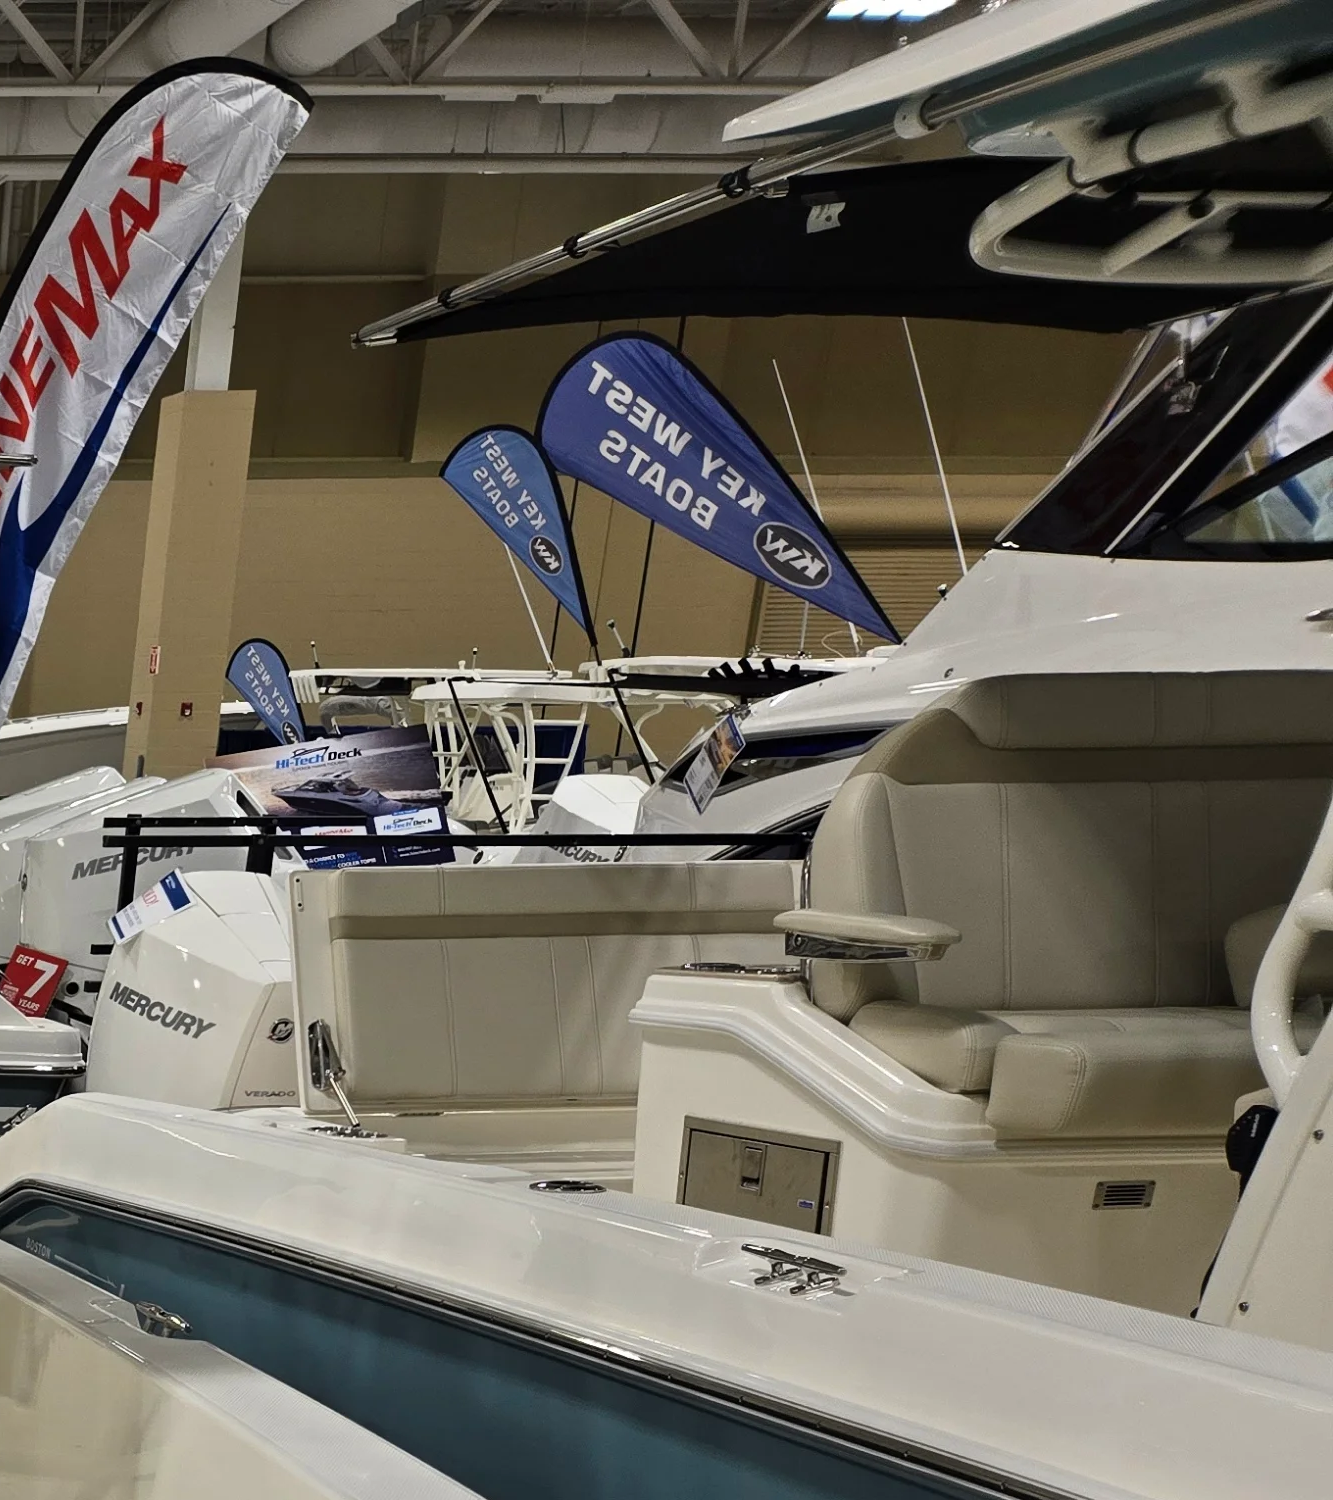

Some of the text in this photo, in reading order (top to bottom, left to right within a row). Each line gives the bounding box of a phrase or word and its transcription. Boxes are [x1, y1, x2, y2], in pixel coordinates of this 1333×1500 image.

[327, 747, 363, 761] Deck
[15, 953, 35, 967] GET
[23, 959, 59, 998] 7
[17, 998, 40, 1012] YEARS
[108, 981, 217, 1040] MERCURY
[244, 1089, 296, 1098] VERADO
[25, 1236, 52, 1260] BOSTON
